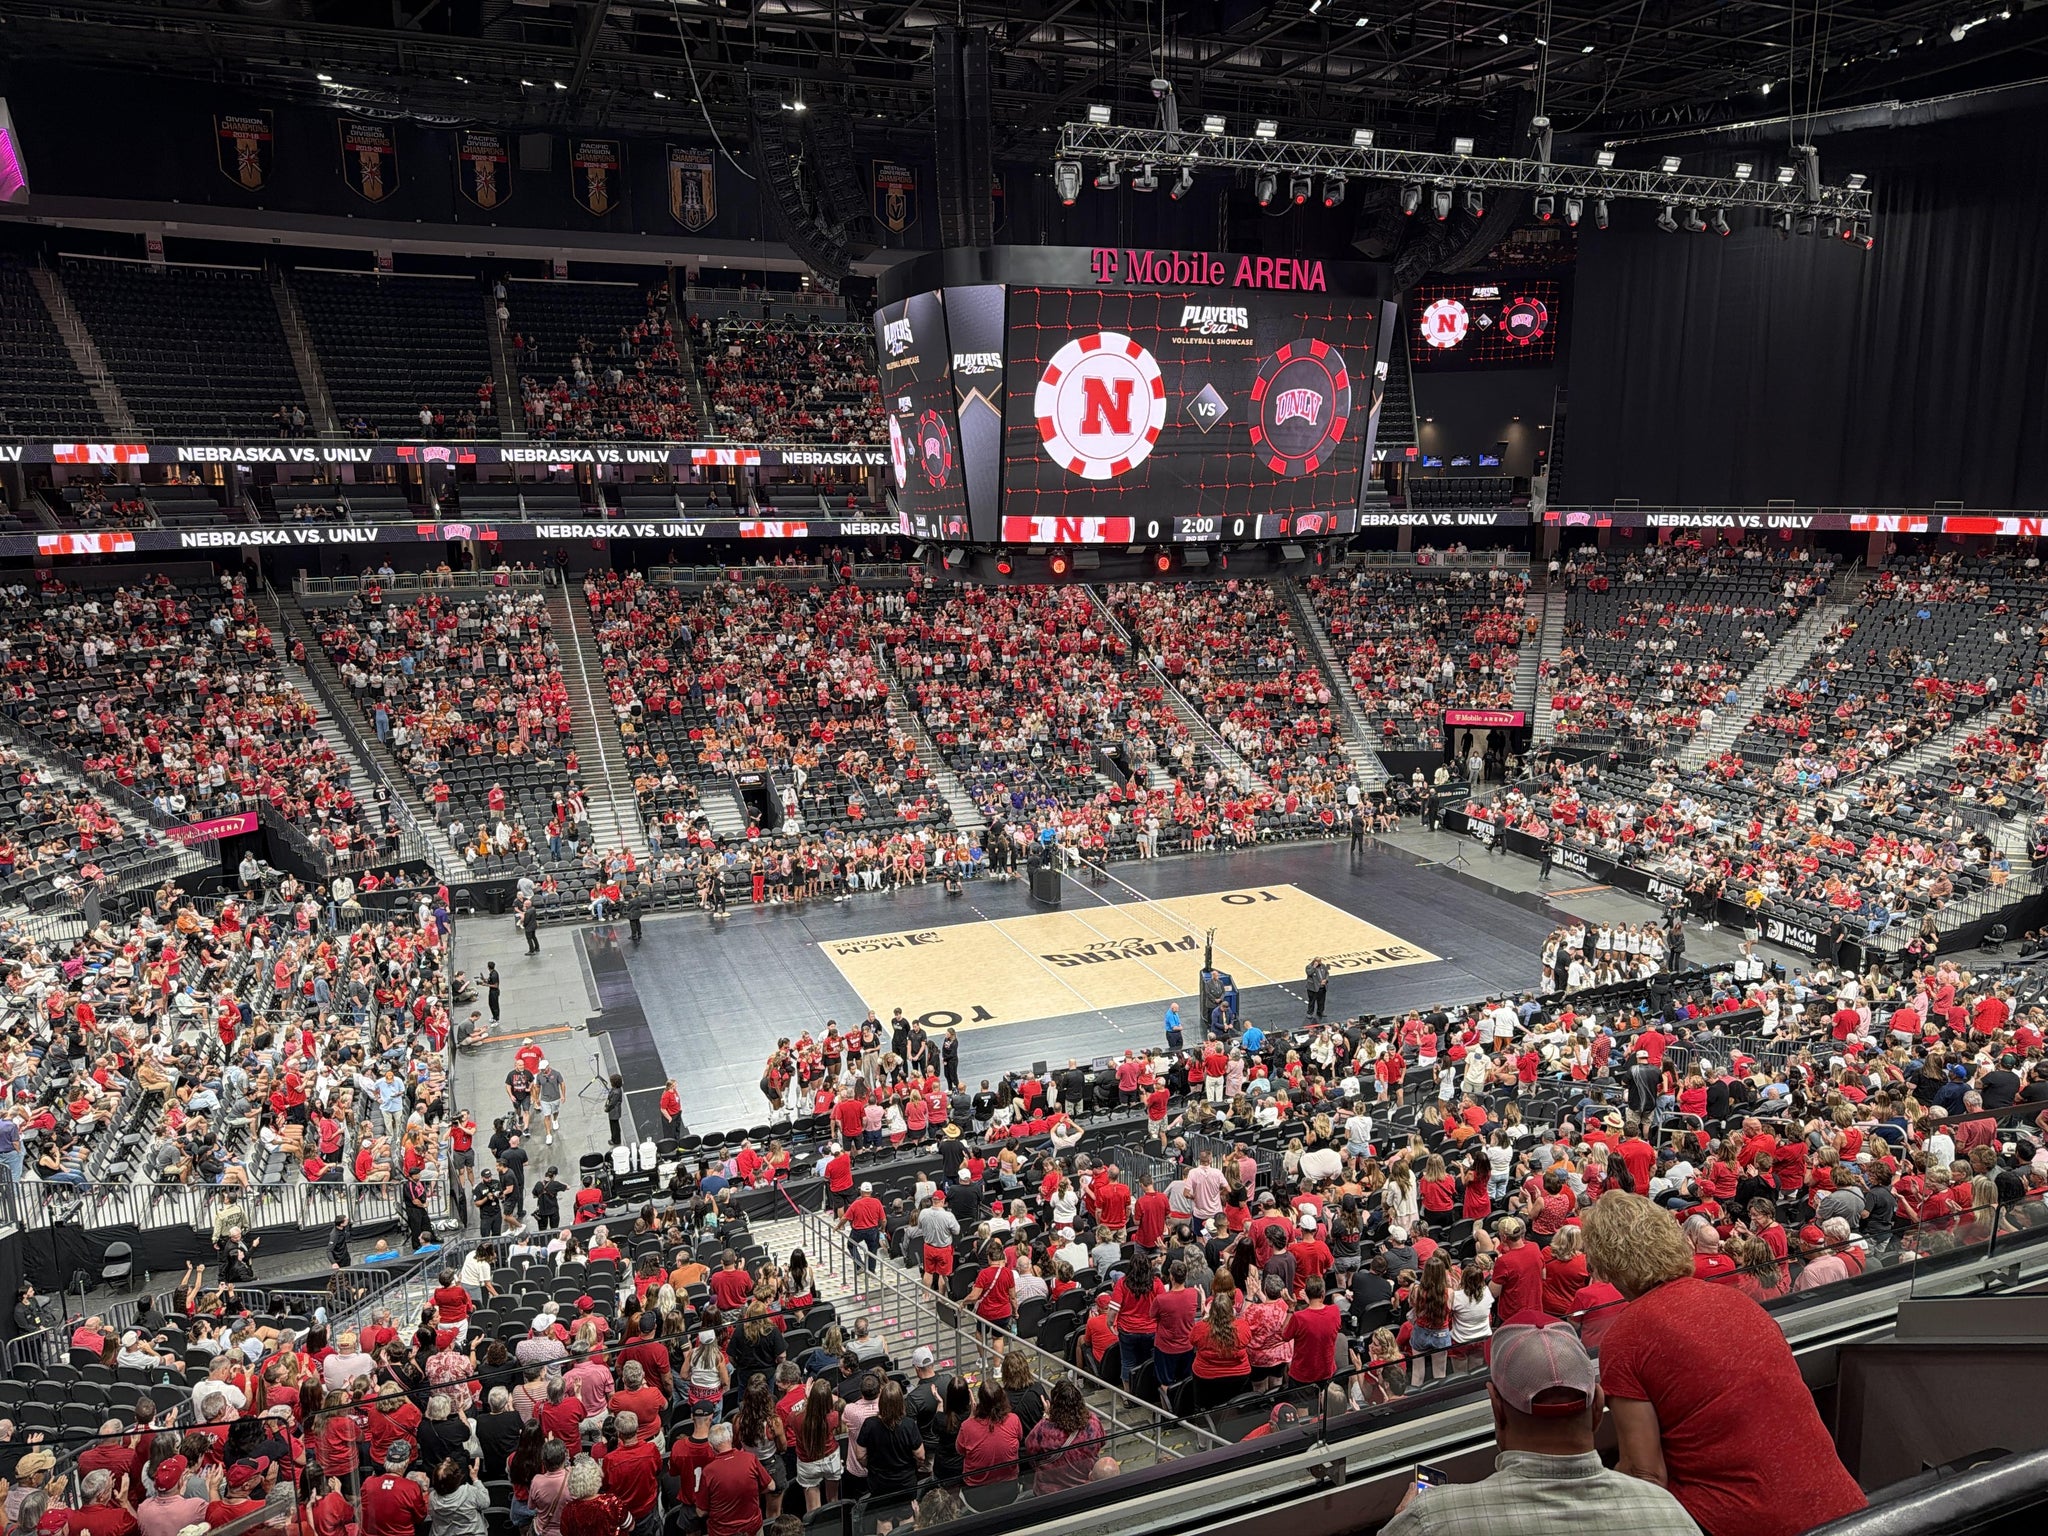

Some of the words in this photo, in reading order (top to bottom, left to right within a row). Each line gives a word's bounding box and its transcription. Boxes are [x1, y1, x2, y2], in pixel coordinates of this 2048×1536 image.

[221, 121, 269, 133] CHAMPIONS
[225, 115, 263, 125] DIVISION
[350, 129, 385, 138] DIVISION
[351, 124, 383, 133] PACIFIC
[346, 136, 391, 146] CHAMPIONS
[466, 140, 500, 148] DIVISION
[467, 134, 498, 142] PACIFIC
[462, 146, 505, 156] CHAMPIONS
[575, 153, 616, 162] CHAMPIONS
[671, 153, 710, 163] CHAMPIONS
[878, 174, 913, 184] CHAMPIONS
[1125, 250, 1226, 286] Mobile
[1234, 255, 1328, 292] ARENA
[1180, 305, 1249, 329] PLAYERS
[1437, 314, 1456, 333] N
[883, 318, 914, 351] PLAYERS
[1199, 320, 1228, 335] Era
[1172, 337, 1215, 346] VOLLEYBALL
[1216, 338, 1254, 346] SHOWCASE
[953, 352, 1003, 371] PLAYERS
[965, 363, 986, 376] Era
[1081, 376, 1135, 436] N
[1198, 402, 1216, 417] VS
[1275, 388, 1323, 426] UNLV
[88, 444, 116, 463] N
[178, 447, 287, 462] NEBRASKA
[288, 448, 320, 462] VS.
[323, 448, 373, 462] UNLV
[501, 449, 594, 463] NEBRASKA
[599, 450, 624, 463] VS.
[626, 450, 670, 463] UNLV
[715, 449, 737, 465] N
[782, 452, 863, 465] NEBRASKA
[865, 453, 888, 465] VS.
[1432, 514, 1454, 526] VS.
[1457, 513, 1498, 526] UNLV
[1646, 514, 1735, 528] NEBRASKA
[1737, 515, 1764, 528] VS.
[1768, 515, 1813, 529] UNLV
[1876, 516, 1900, 531] N
[536, 525, 630, 538] NEBRASKA
[633, 524, 660, 537] VS.
[662, 524, 706, 537] UNLV
[763, 522, 784, 538] N
[1056, 517, 1084, 543] N
[1147, 520, 1159, 539] 0
[1181, 518, 1214, 533] 2:00
[1233, 518, 1244, 536] 0
[1296, 515, 1322, 535] UNLV
[72, 534, 101, 553] N
[181, 530, 291, 547] NEBRASKA
[293, 528, 325, 544] VS.
[328, 527, 379, 542] UNLV
[41, 571, 48, 581] 8
[1462, 714, 1482, 722] Mobile
[206, 823, 239, 835] ARENA
[1564, 849, 1588, 867] MGM
[1563, 860, 1587, 873] REWARDS
[1785, 924, 1818, 947] MGM
[836, 941, 905, 956] MGM
[1040, 935, 1200, 968] PLAYERS
[1784, 937, 1817, 954] REWARDS
[933, 1099, 941, 1109] 2
[983, 1099, 989, 1107] 7
[622, 1176, 650, 1185] POWERADE
